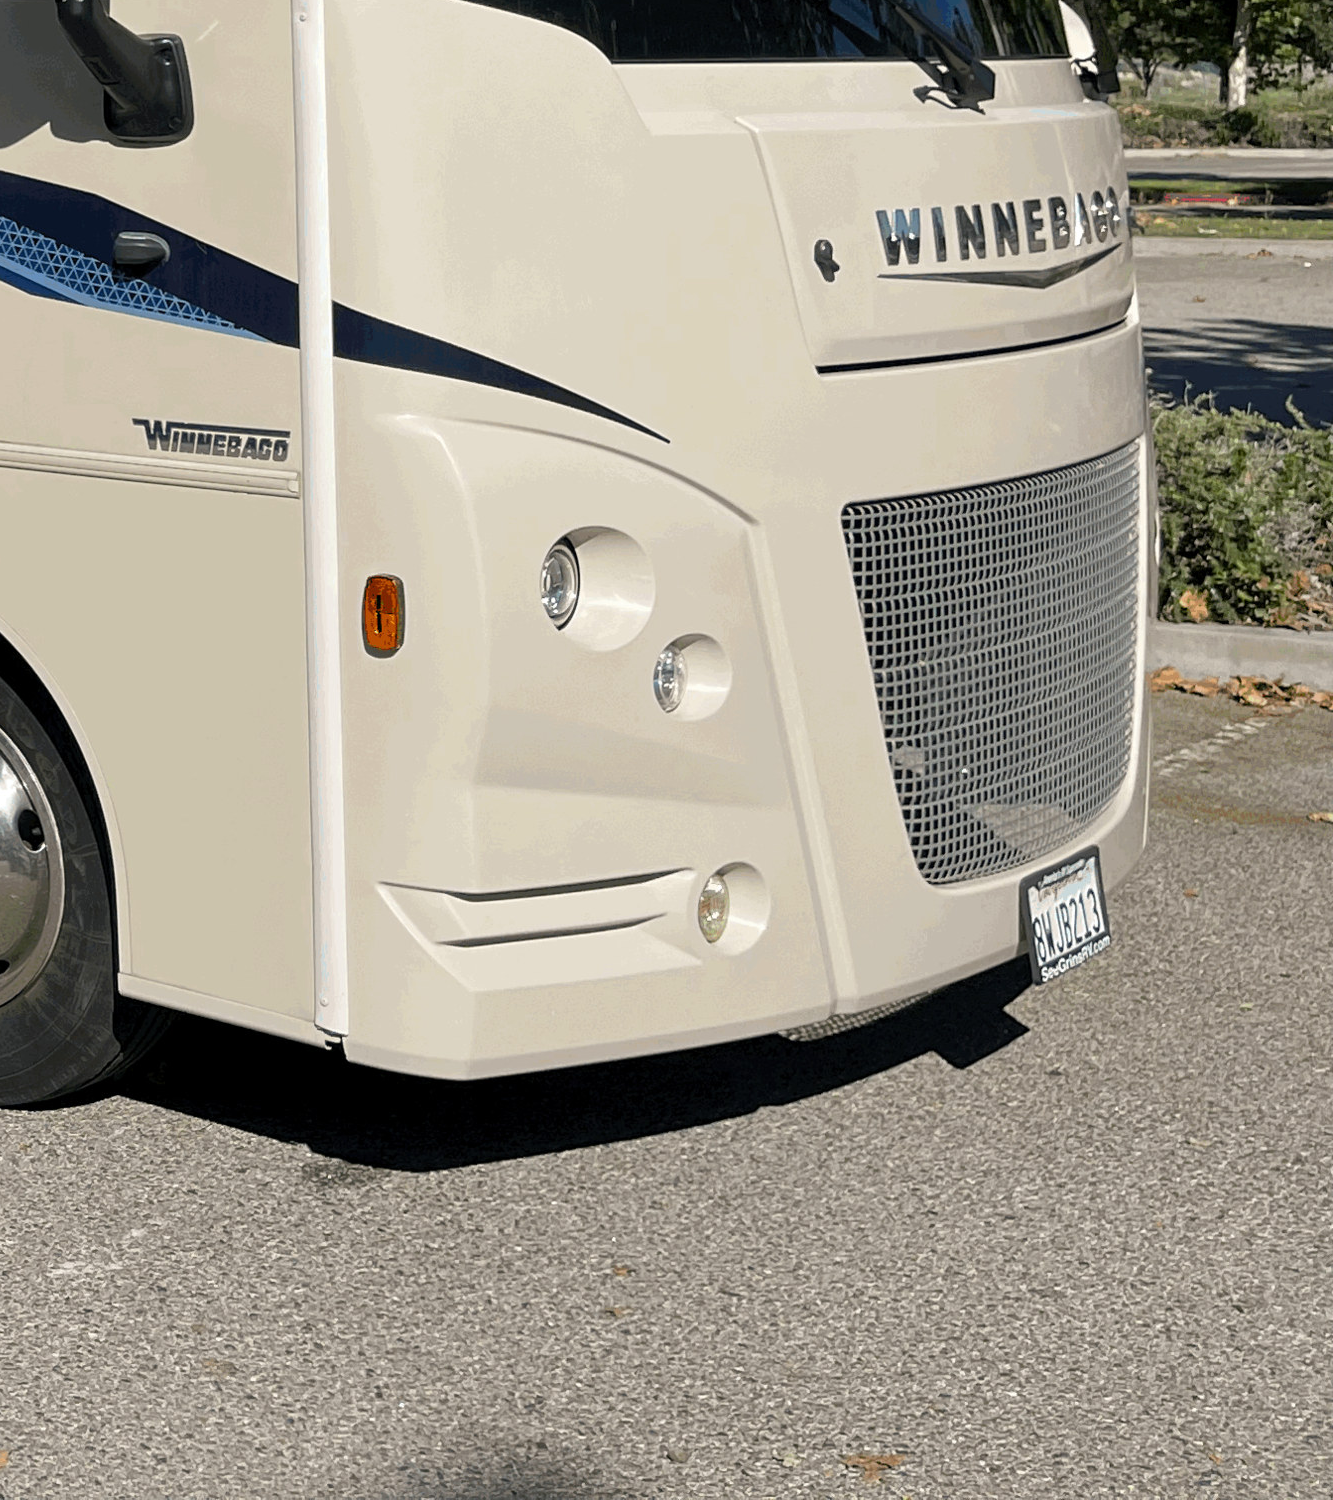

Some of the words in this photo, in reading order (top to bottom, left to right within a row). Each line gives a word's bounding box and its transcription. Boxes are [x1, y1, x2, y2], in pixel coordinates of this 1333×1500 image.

[875, 185, 1120, 266] WINNEBAGO
[1032, 887, 1101, 964] 8WJB213
[1041, 935, 1111, 982] SeeGrinsRV.com
